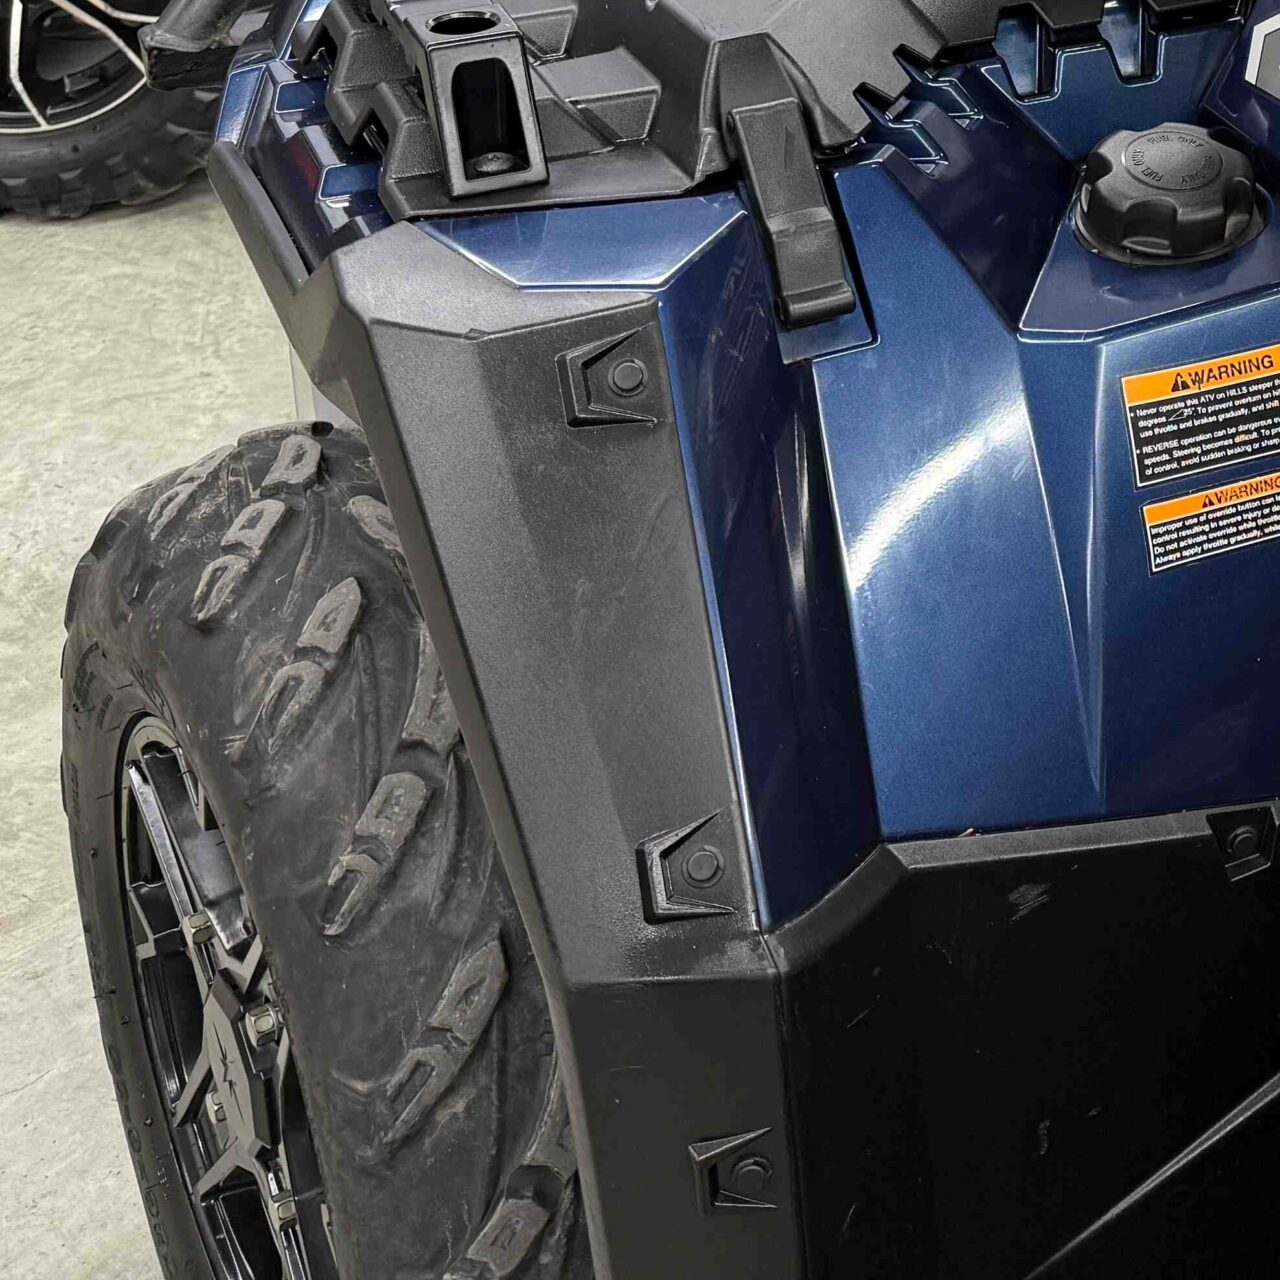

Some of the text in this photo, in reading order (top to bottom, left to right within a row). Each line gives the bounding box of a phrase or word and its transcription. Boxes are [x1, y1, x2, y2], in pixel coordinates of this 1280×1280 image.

[1188, 354, 1274, 386] WARNING
[1200, 393, 1214, 403] ATV
[1226, 386, 1248, 398] HILLS
[1142, 439, 1180, 454] REVERSE
[1154, 546, 1165, 555] Do
